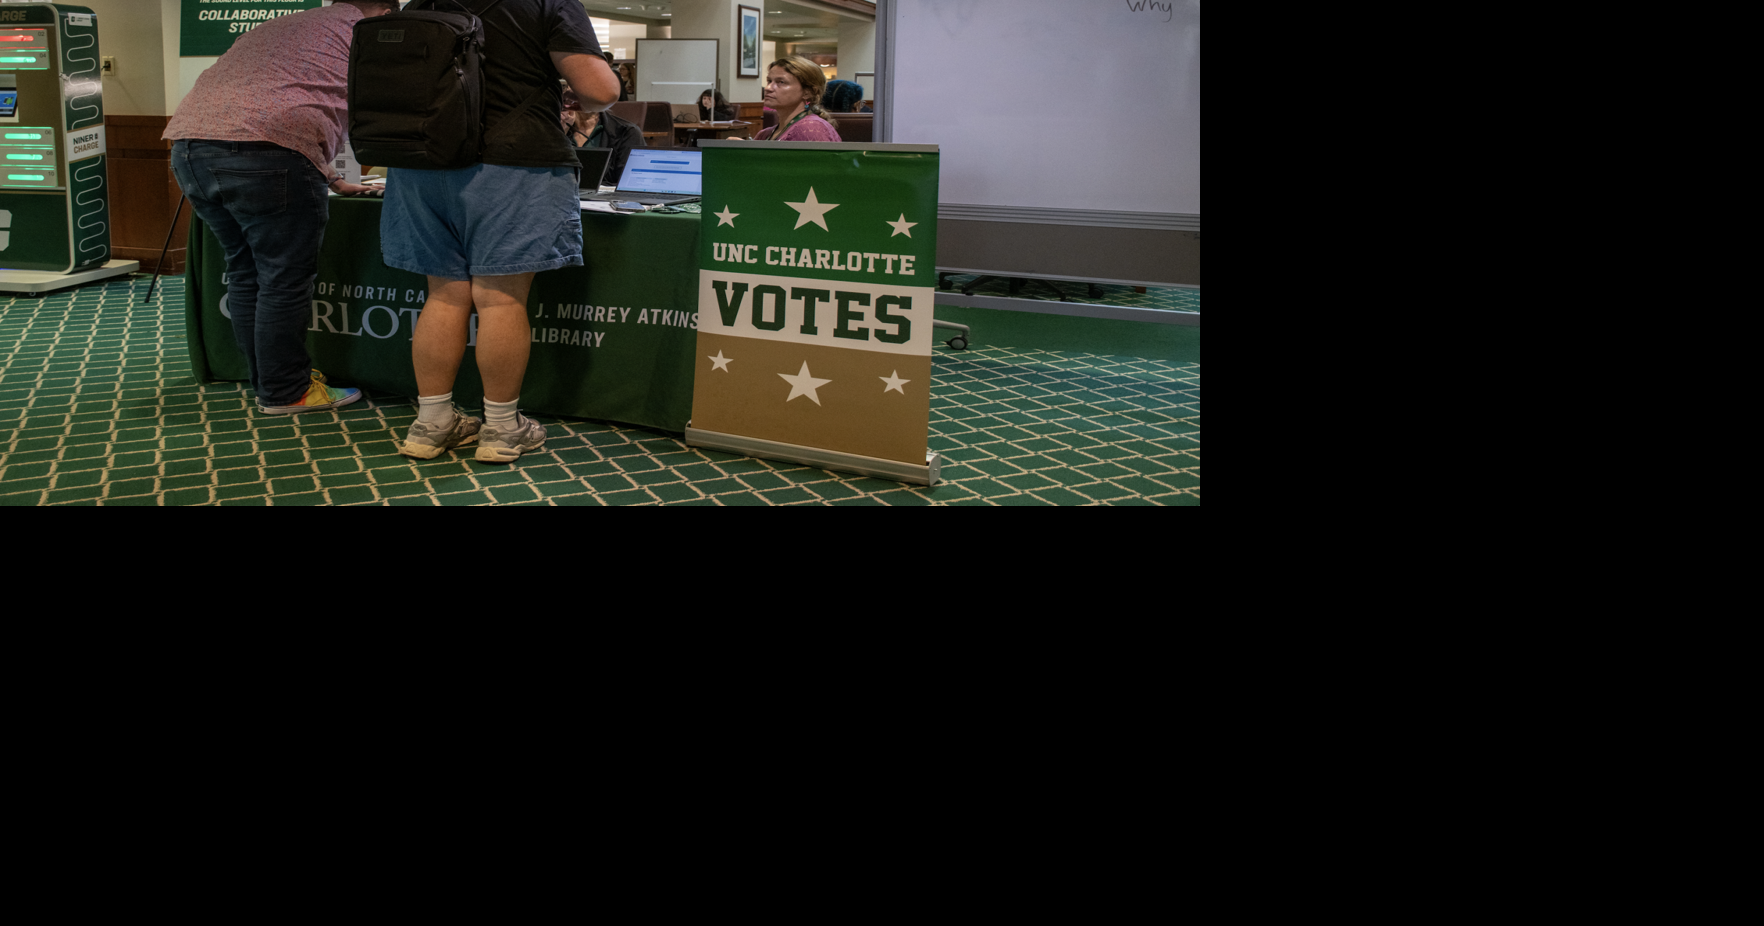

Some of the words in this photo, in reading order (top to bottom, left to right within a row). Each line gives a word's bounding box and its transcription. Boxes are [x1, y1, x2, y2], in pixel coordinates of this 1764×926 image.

[0, 10, 27, 21] RGE
[199, 9, 305, 20] COLLABORATI
[229, 22, 263, 33] STU
[73, 133, 94, 145] NINER
[73, 141, 99, 154] CHARGE
[713, 242, 758, 264] UNC
[765, 246, 916, 275] CHARLOTTE
[318, 282, 336, 295] OF
[342, 285, 397, 301] NORTH
[535, 303, 549, 319] J.
[557, 303, 631, 323] MURREY
[637, 308, 699, 330] ATKINS
[712, 280, 912, 344] VOTES
[531, 328, 605, 348] LIBRARY
